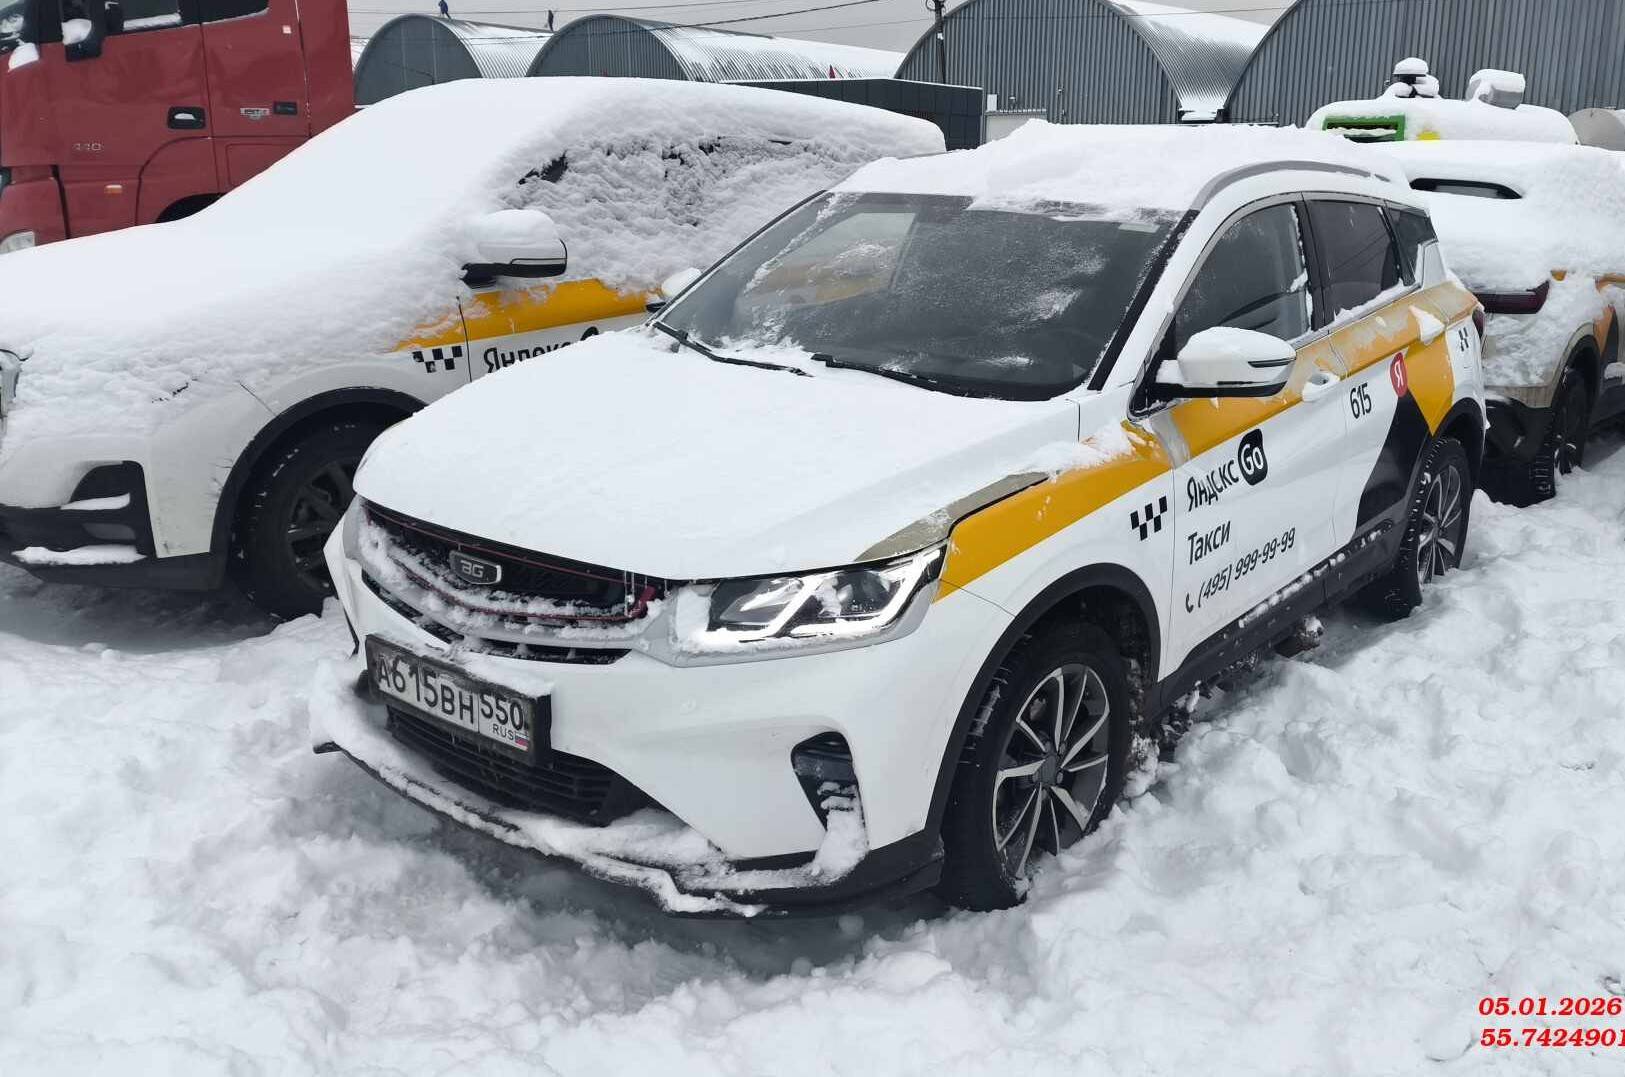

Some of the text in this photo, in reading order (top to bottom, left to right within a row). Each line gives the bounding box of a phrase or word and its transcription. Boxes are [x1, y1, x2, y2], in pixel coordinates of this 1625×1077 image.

[1393, 359, 1405, 388] Я
[1350, 382, 1372, 420] 615
[1241, 443, 1264, 475] Go
[1187, 520, 1231, 565] Такси
[1197, 527, 1296, 608] (495) 999-99-99
[480, 693, 524, 731] 550
[491, 723, 514, 741] RUS
